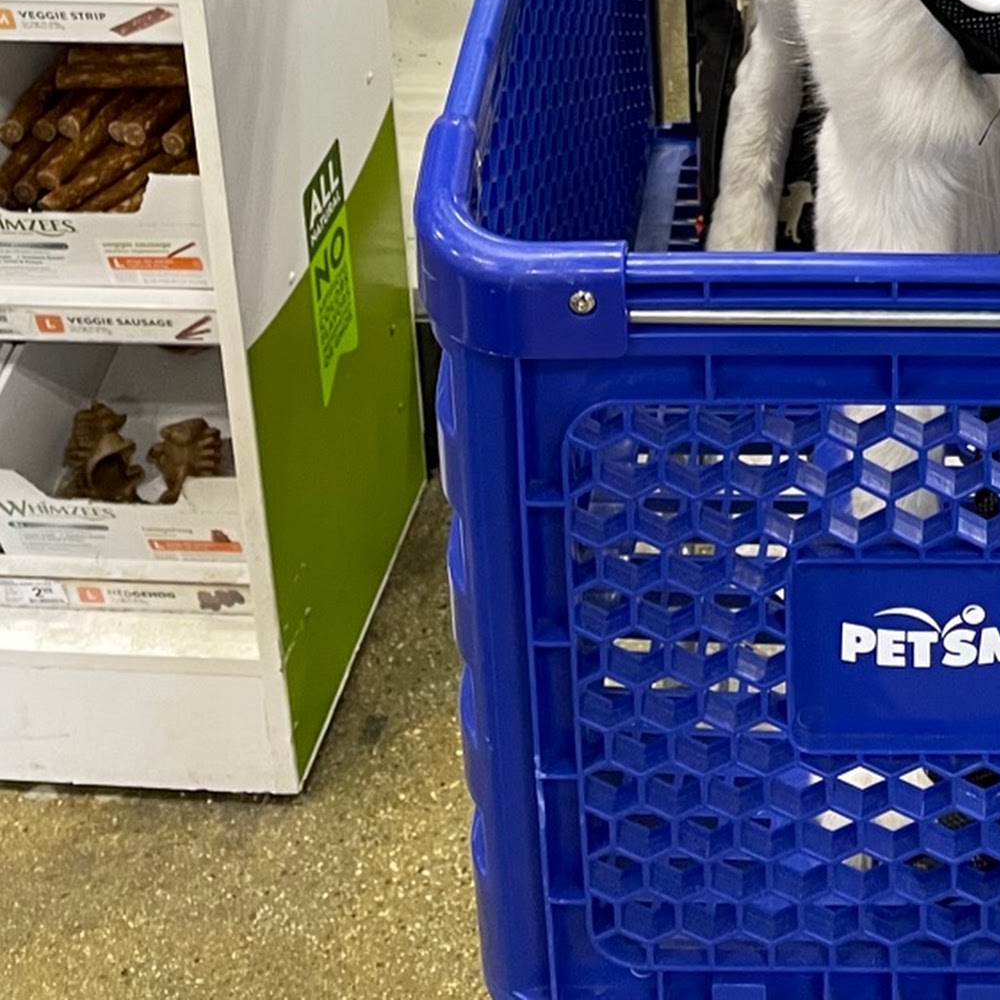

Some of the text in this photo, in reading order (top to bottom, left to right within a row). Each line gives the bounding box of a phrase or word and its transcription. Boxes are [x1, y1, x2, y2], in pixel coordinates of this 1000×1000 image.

[18, 10, 106, 22] VEGGIE STRIP
[309, 161, 340, 230] ALL
[315, 226, 345, 299] NO
[45, 318, 56, 329] L
[67, 316, 173, 328] VEGGIE SAUSAGE
